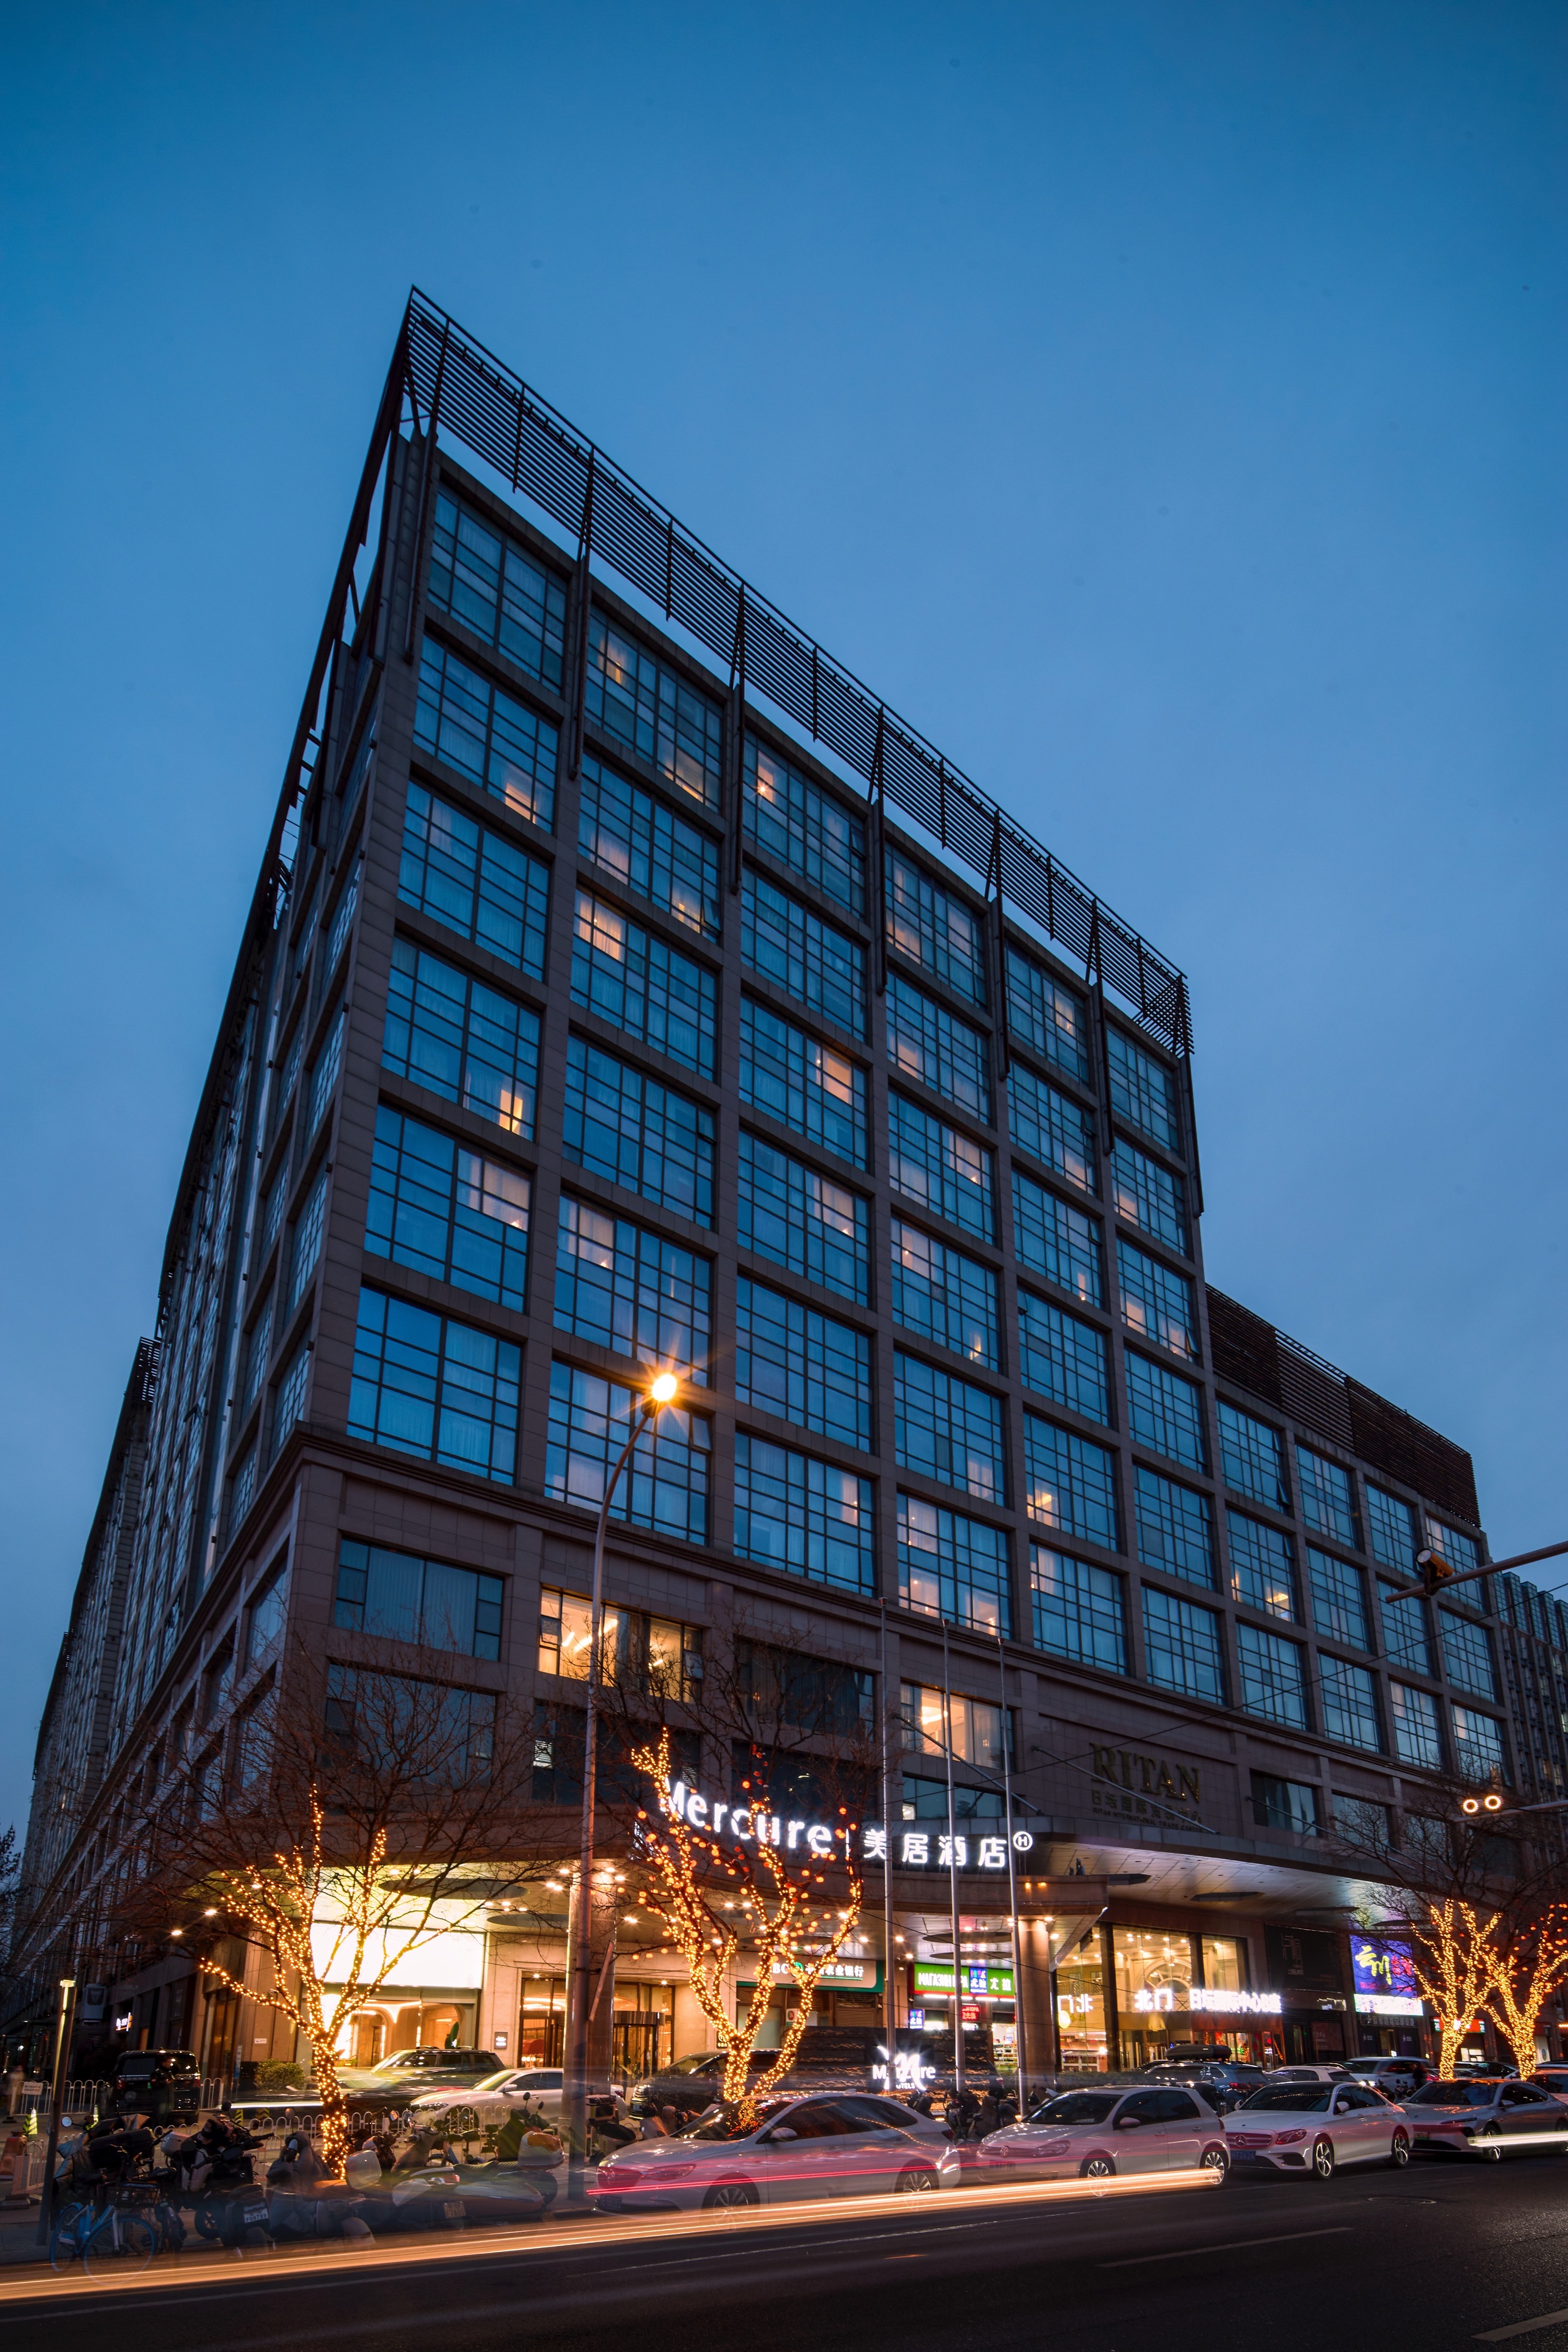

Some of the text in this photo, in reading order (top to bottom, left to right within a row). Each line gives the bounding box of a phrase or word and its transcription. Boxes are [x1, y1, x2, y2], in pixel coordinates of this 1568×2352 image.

[1089, 1743, 1200, 1803] RITAN
[659, 1777, 832, 1854] Mercure
[1159, 1820, 1179, 1830] TRADE
[863, 1828, 1007, 1868] 美居酒店
[918, 1973, 952, 1987] МАГАЗИН
[1135, 1989, 1172, 2011] 北门
[872, 2065, 936, 2079] Mrcure
[246, 2213, 267, 2222] FU6789
